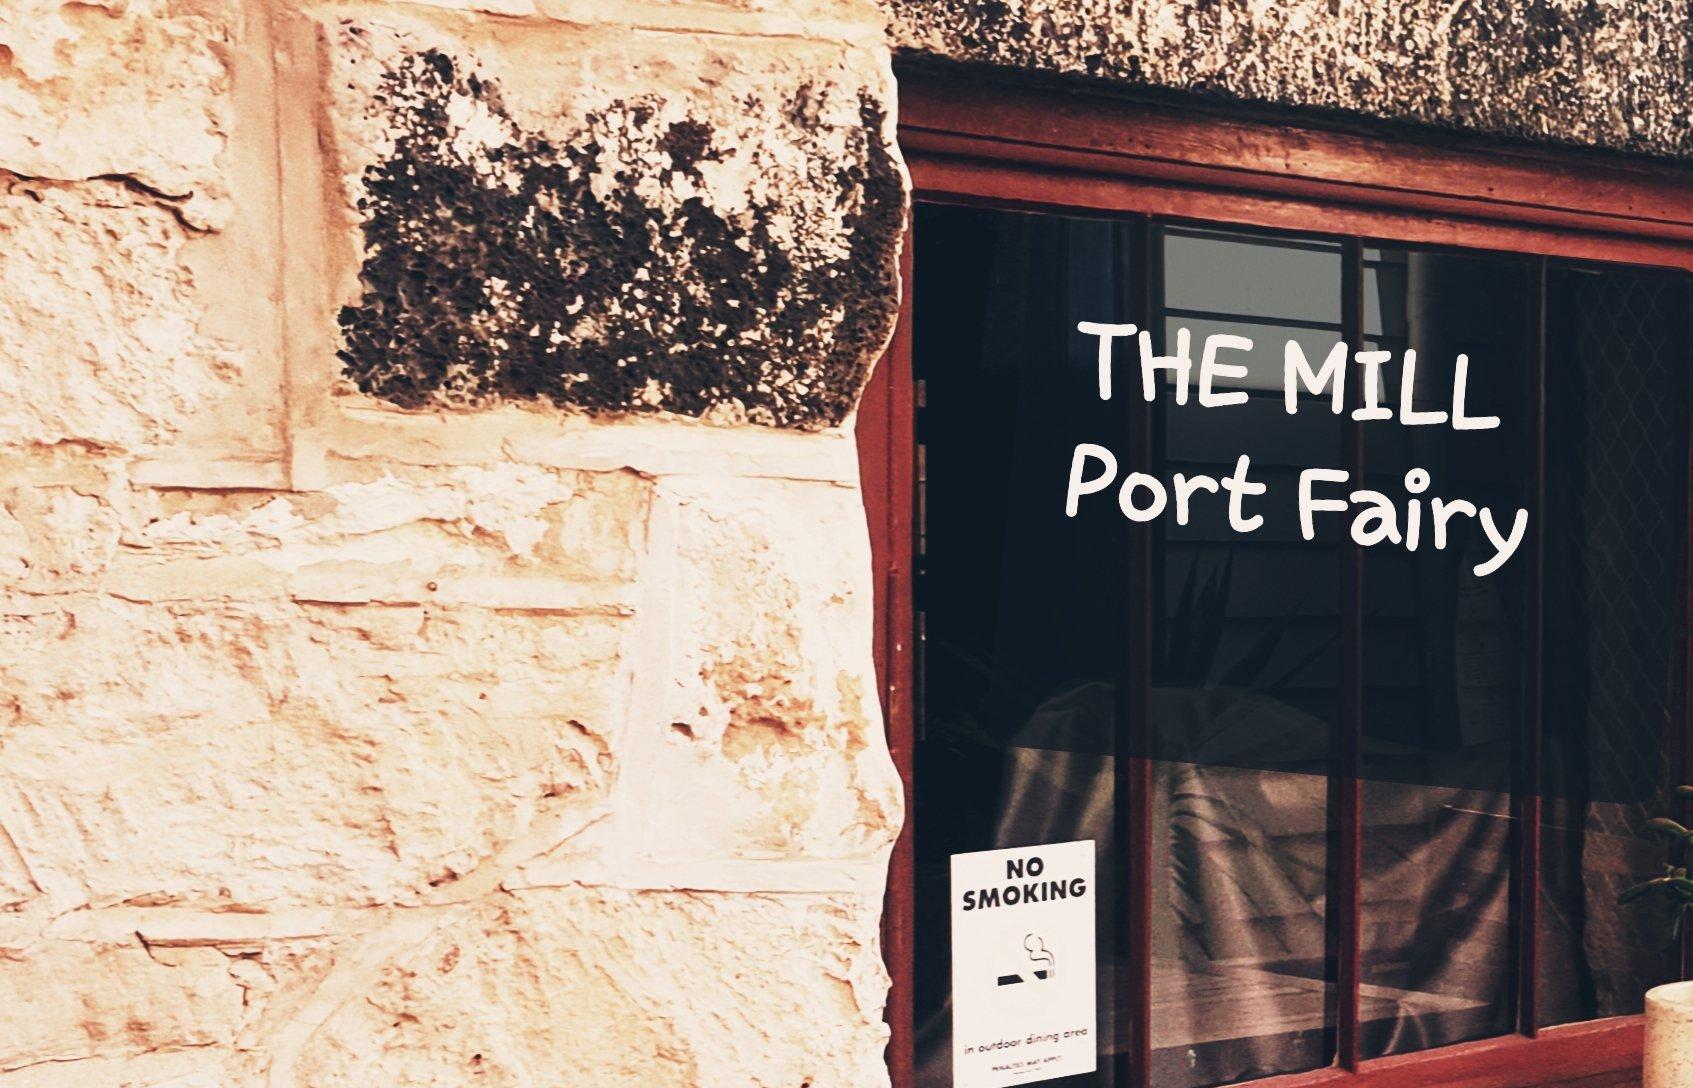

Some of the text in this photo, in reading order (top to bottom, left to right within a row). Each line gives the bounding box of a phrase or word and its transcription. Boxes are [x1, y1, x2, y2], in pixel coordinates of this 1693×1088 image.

[1006, 856, 1044, 880] NO
[962, 877, 1087, 911] SMOKING
[964, 1028, 1088, 1055] in outdoor dining area
